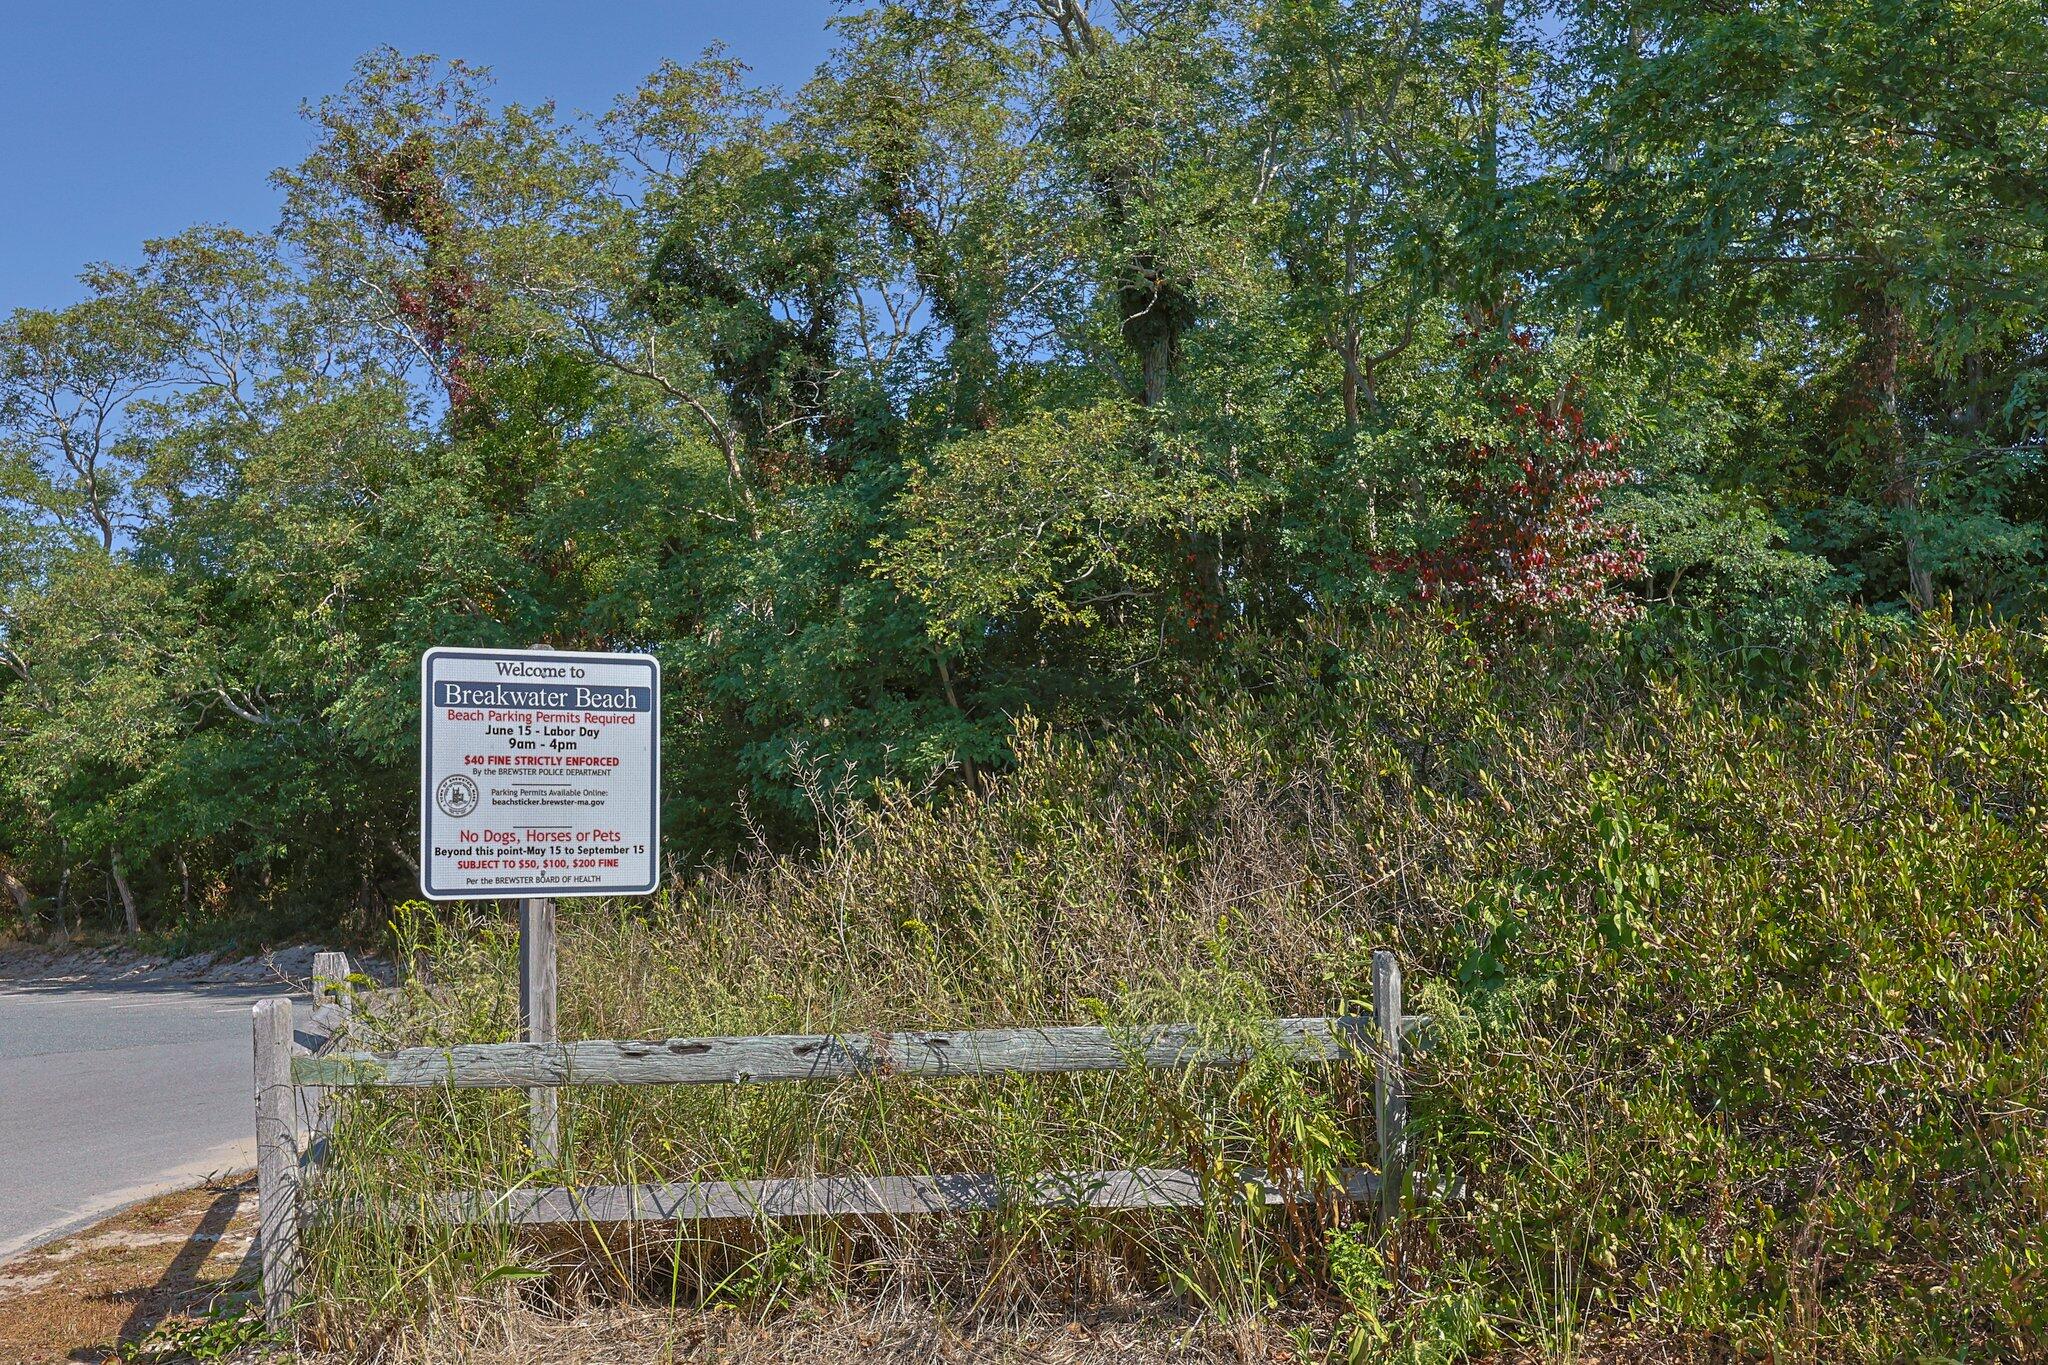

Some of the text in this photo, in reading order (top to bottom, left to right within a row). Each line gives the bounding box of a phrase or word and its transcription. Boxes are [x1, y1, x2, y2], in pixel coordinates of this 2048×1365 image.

[496, 662, 584, 678] Welcome to
[444, 684, 637, 708] Breakwater Beach
[448, 710, 635, 726] Beach Parking Permits Required
[485, 726, 513, 735] June
[519, 726, 531, 735] 15
[544, 726, 575, 736] Labor
[580, 728, 599, 739] Day
[509, 738, 535, 749] 9am
[550, 739, 577, 752] 4pm
[464, 755, 619, 766] $40 FINE STRICTLY ENFORCED
[460, 830, 620, 845] No Dogs, Horses or Pets
[435, 847, 472, 858] Beyond
[475, 847, 494, 855] this
[497, 847, 545, 857] point-May
[550, 846, 561, 854] 15
[578, 846, 629, 856] September
[633, 846, 644, 854] 15
[458, 859, 618, 870] SUBJECT TO $50, $100, $200 FINE
